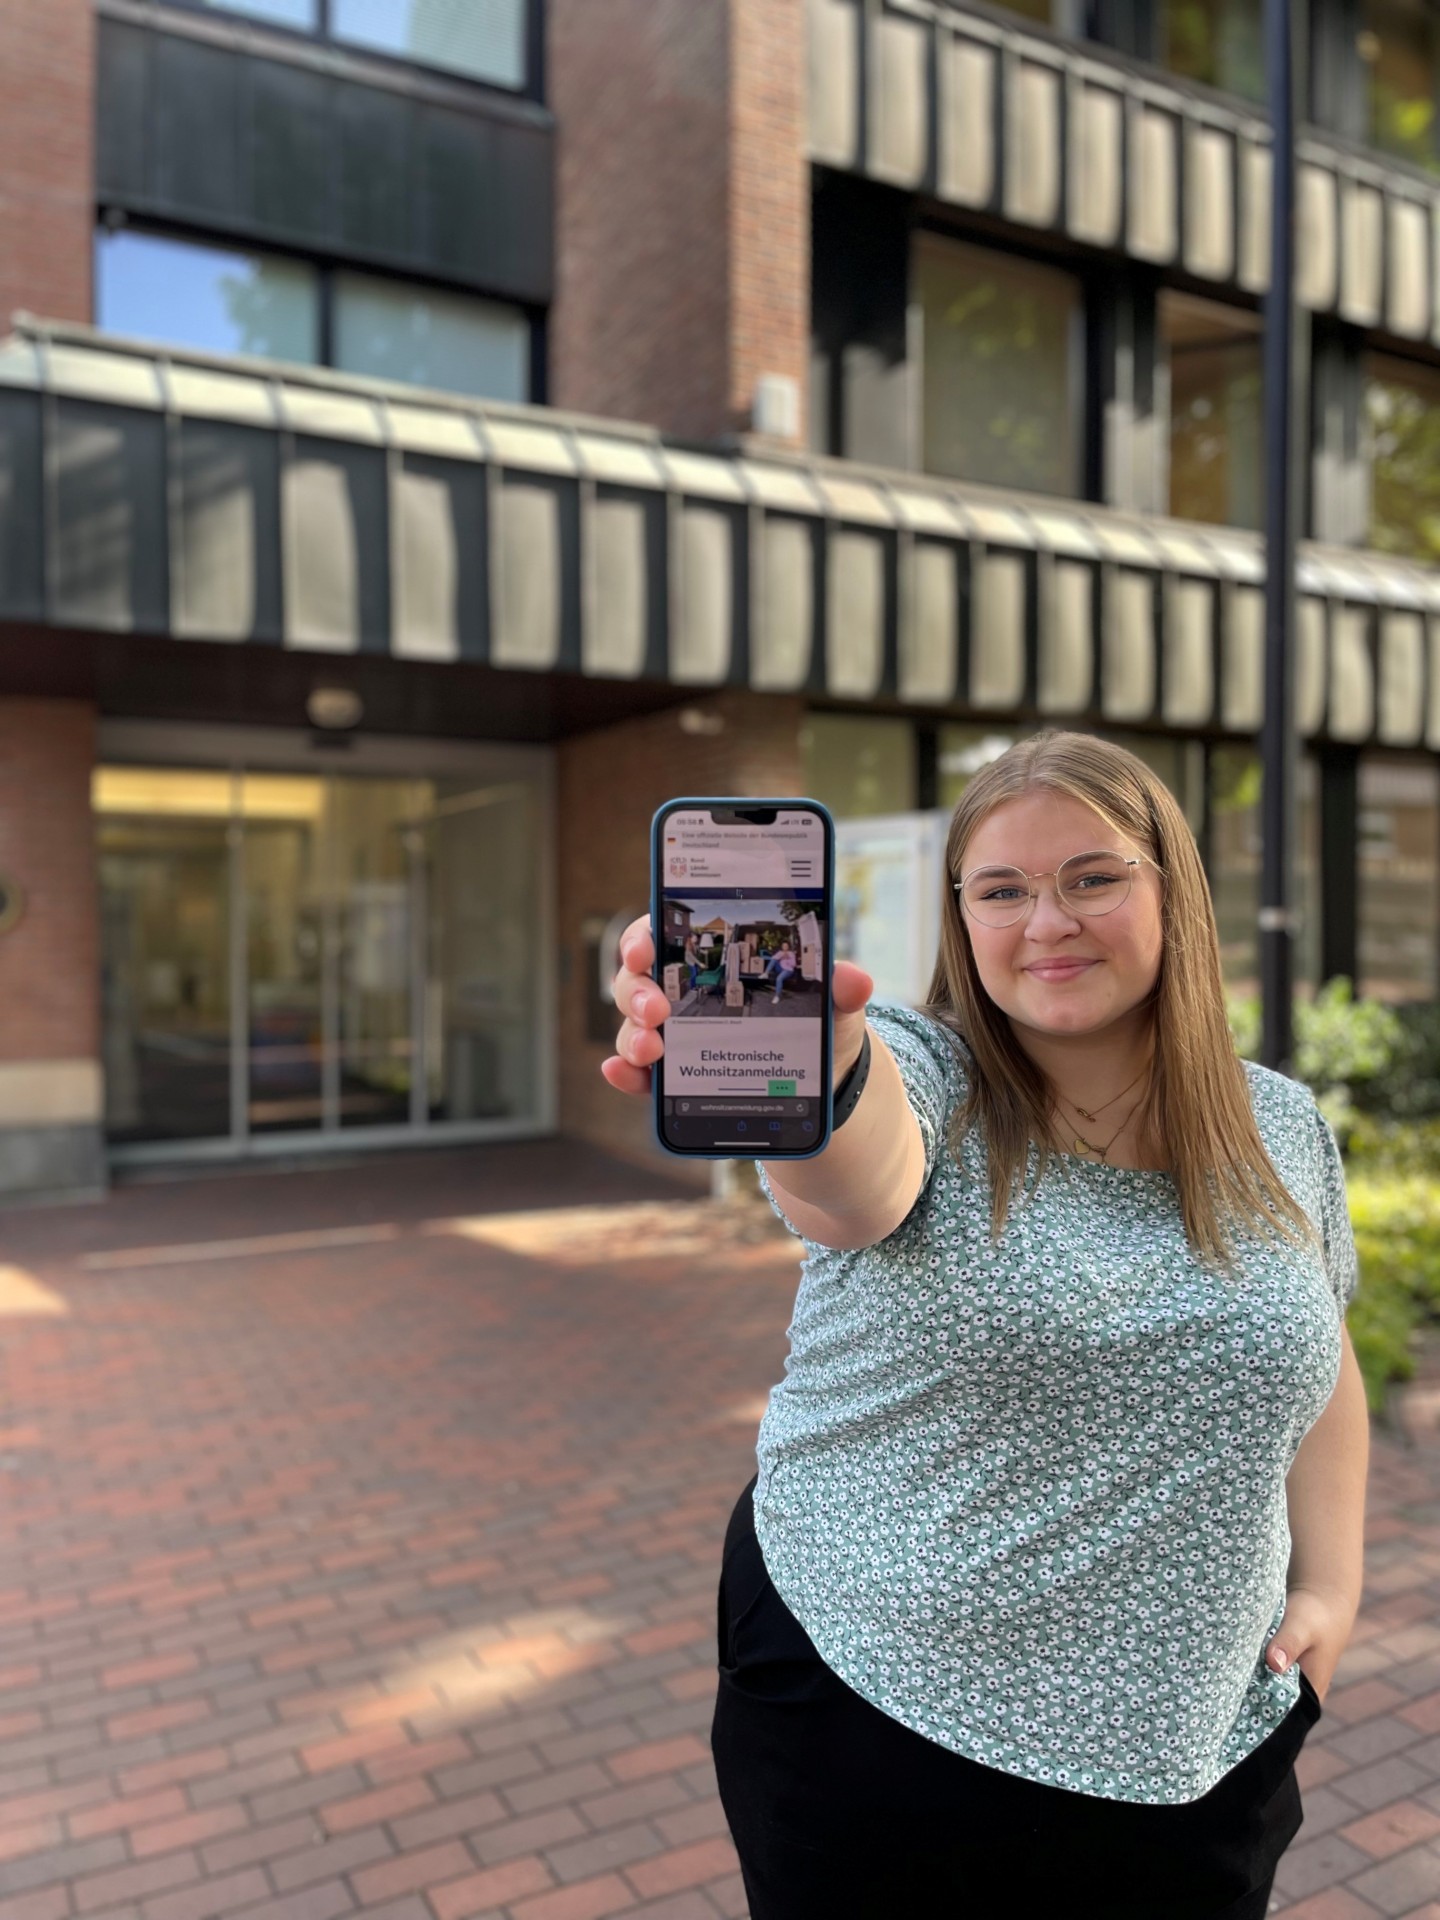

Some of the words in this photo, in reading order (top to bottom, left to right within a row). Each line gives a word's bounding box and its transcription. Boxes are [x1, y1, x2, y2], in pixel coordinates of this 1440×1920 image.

[701, 1050, 785, 1062] Elektronische
[680, 1066, 806, 1079] Wohnsitzanmeldung
[701, 1104, 785, 1113] wohnsitzanmeldung.gov.de
